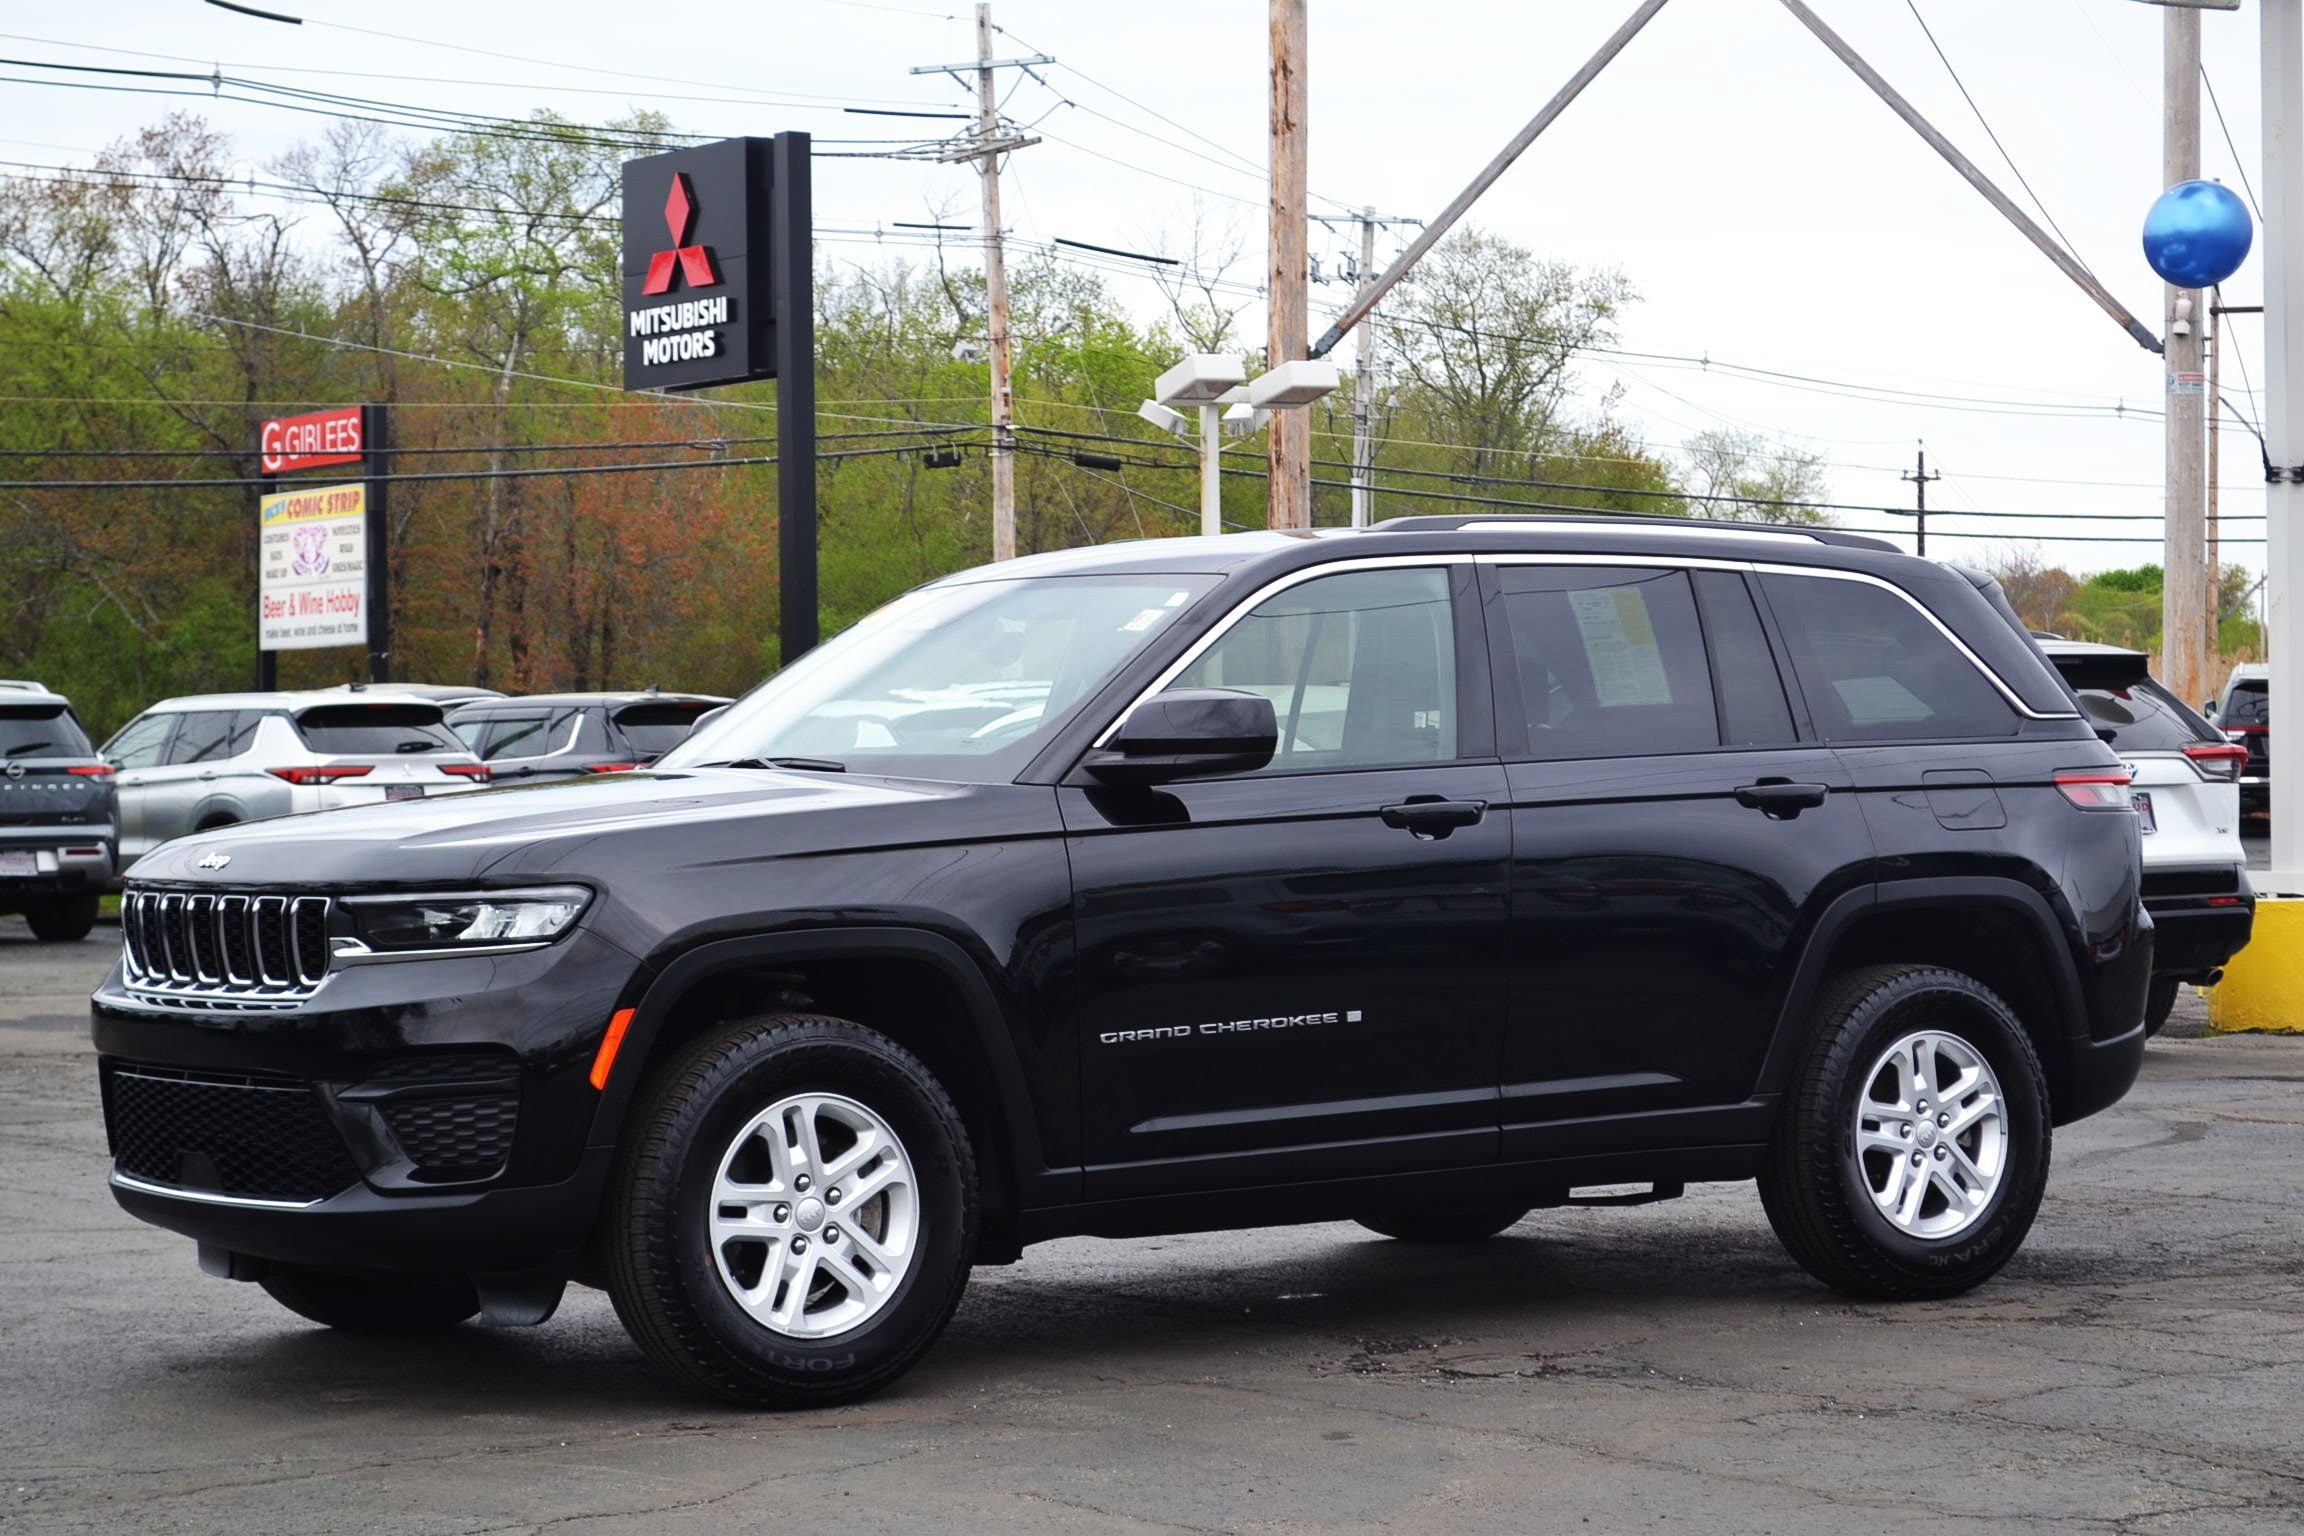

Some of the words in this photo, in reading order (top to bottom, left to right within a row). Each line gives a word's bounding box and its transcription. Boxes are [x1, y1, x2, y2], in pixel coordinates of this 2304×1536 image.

[630, 296, 727, 337] MITSUBISHI
[643, 330, 716, 366] MOTORS
[262, 421, 281, 470] G
[285, 416, 360, 460] GIBLEES
[287, 495, 323, 519] COMIC
[327, 490, 360, 515] STRIP
[264, 595, 286, 618] Beer
[289, 593, 296, 616] &
[299, 591, 323, 615] Wine
[327, 587, 360, 618] Hobby
[198, 851, 231, 870] Jeep
[1099, 1025, 1191, 1044] GRAND
[1199, 1012, 1339, 1034] CHEROKEE
